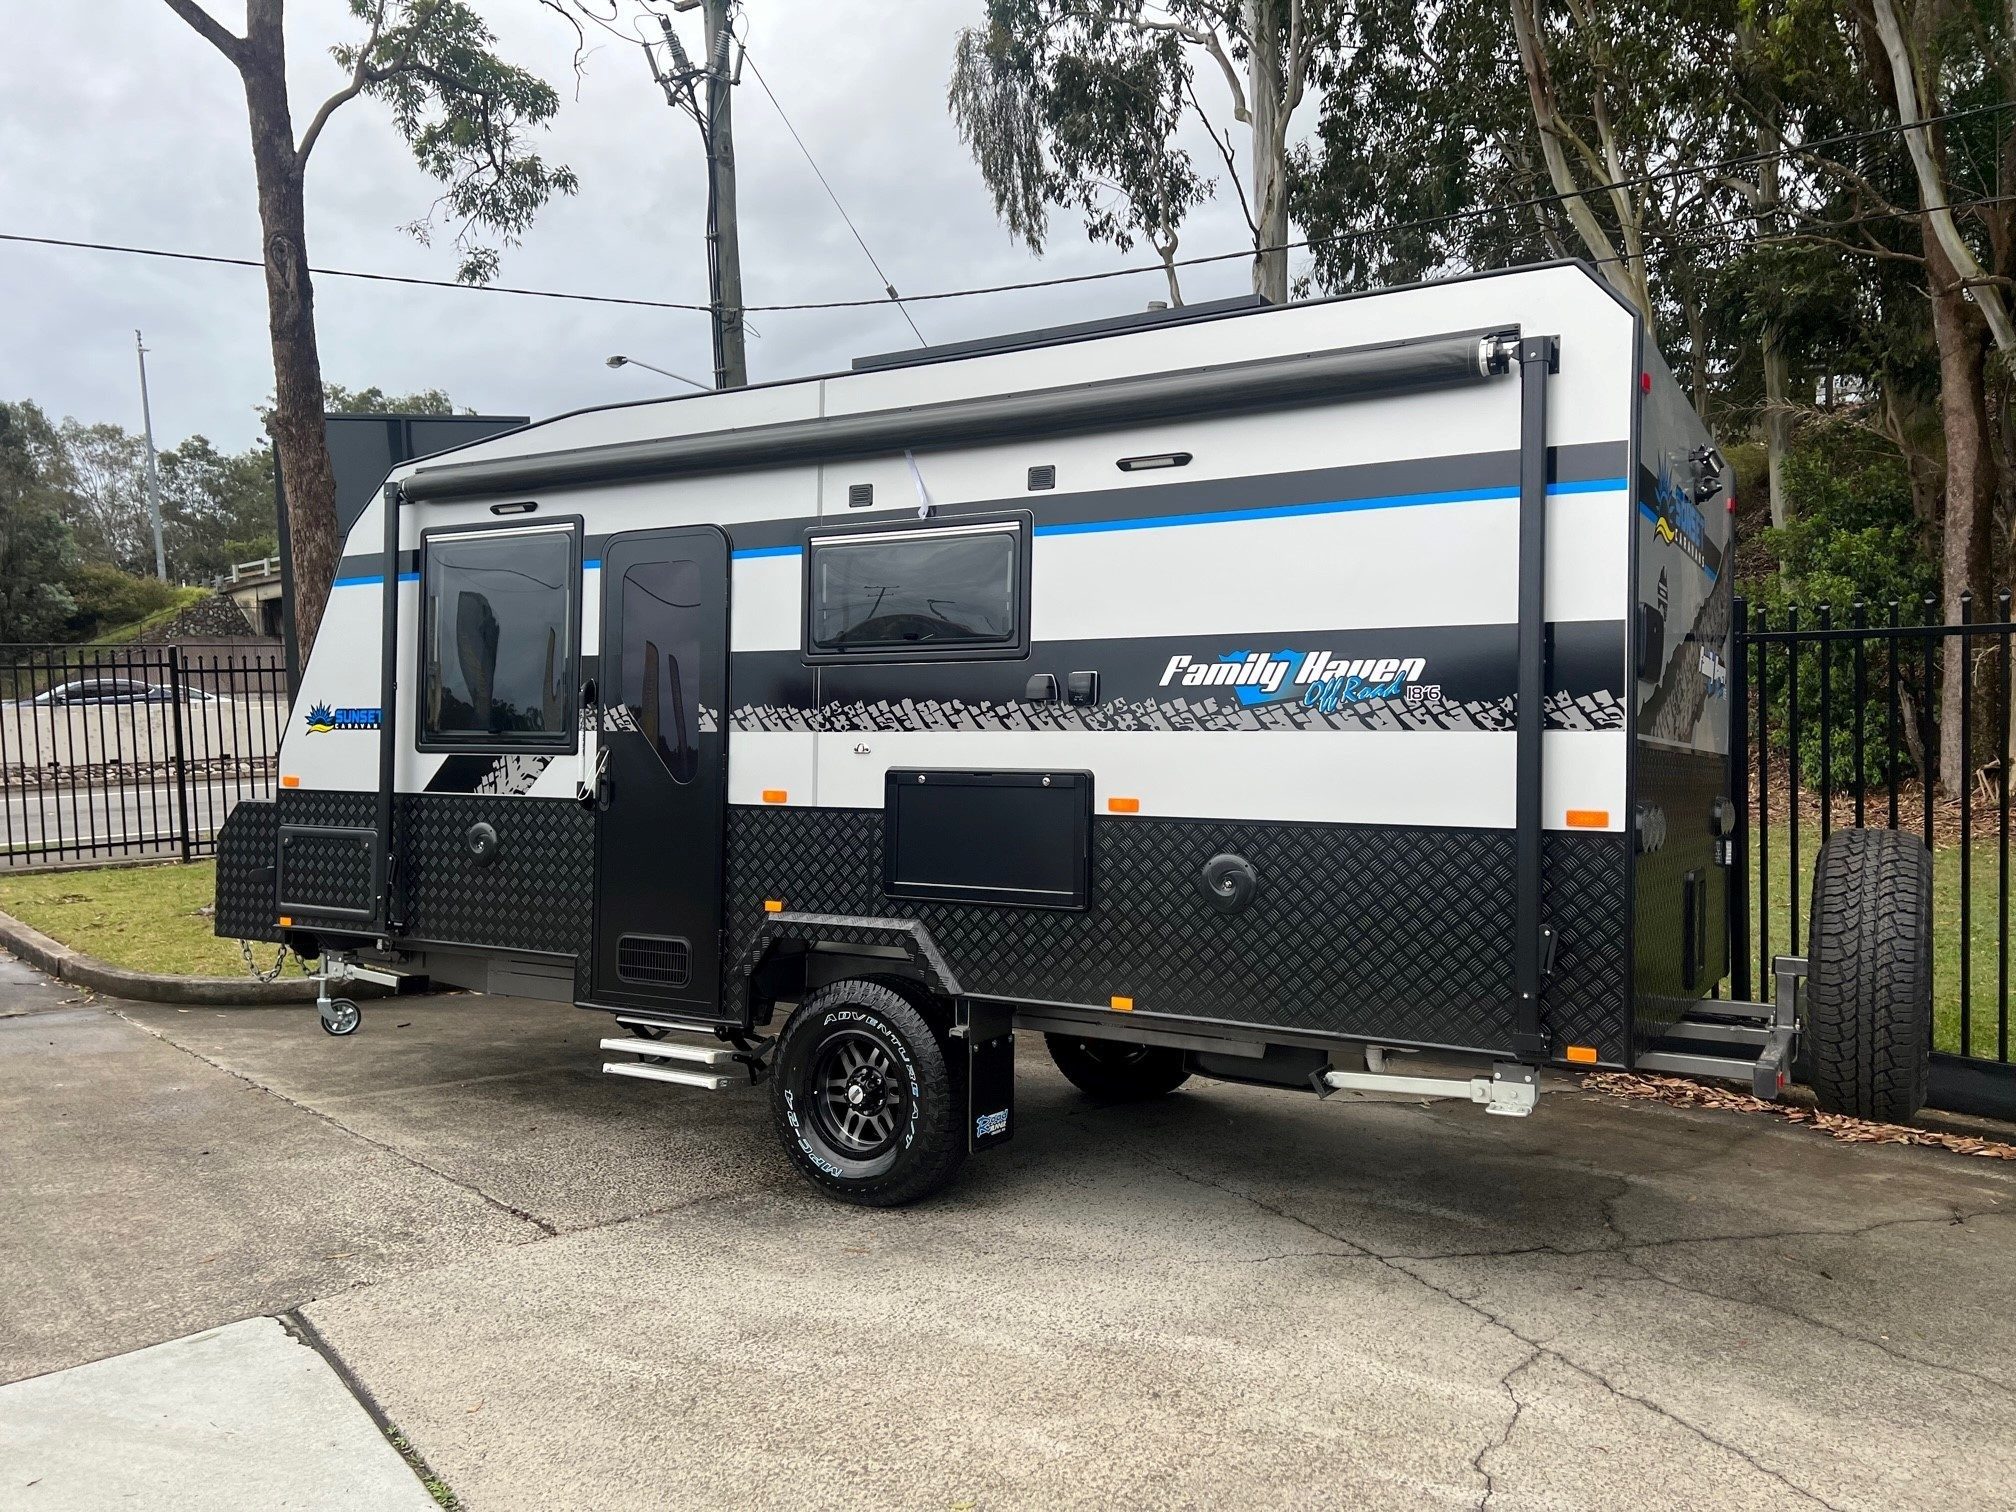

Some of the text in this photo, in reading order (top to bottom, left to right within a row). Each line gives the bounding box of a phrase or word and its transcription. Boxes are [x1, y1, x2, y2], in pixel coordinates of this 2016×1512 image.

[1158, 651, 1427, 692] Family Haven
[1303, 670, 1407, 713] Off Road
[824, 1011, 919, 1098] ADVENTURE
[784, 1089, 844, 1178] MPC-24
